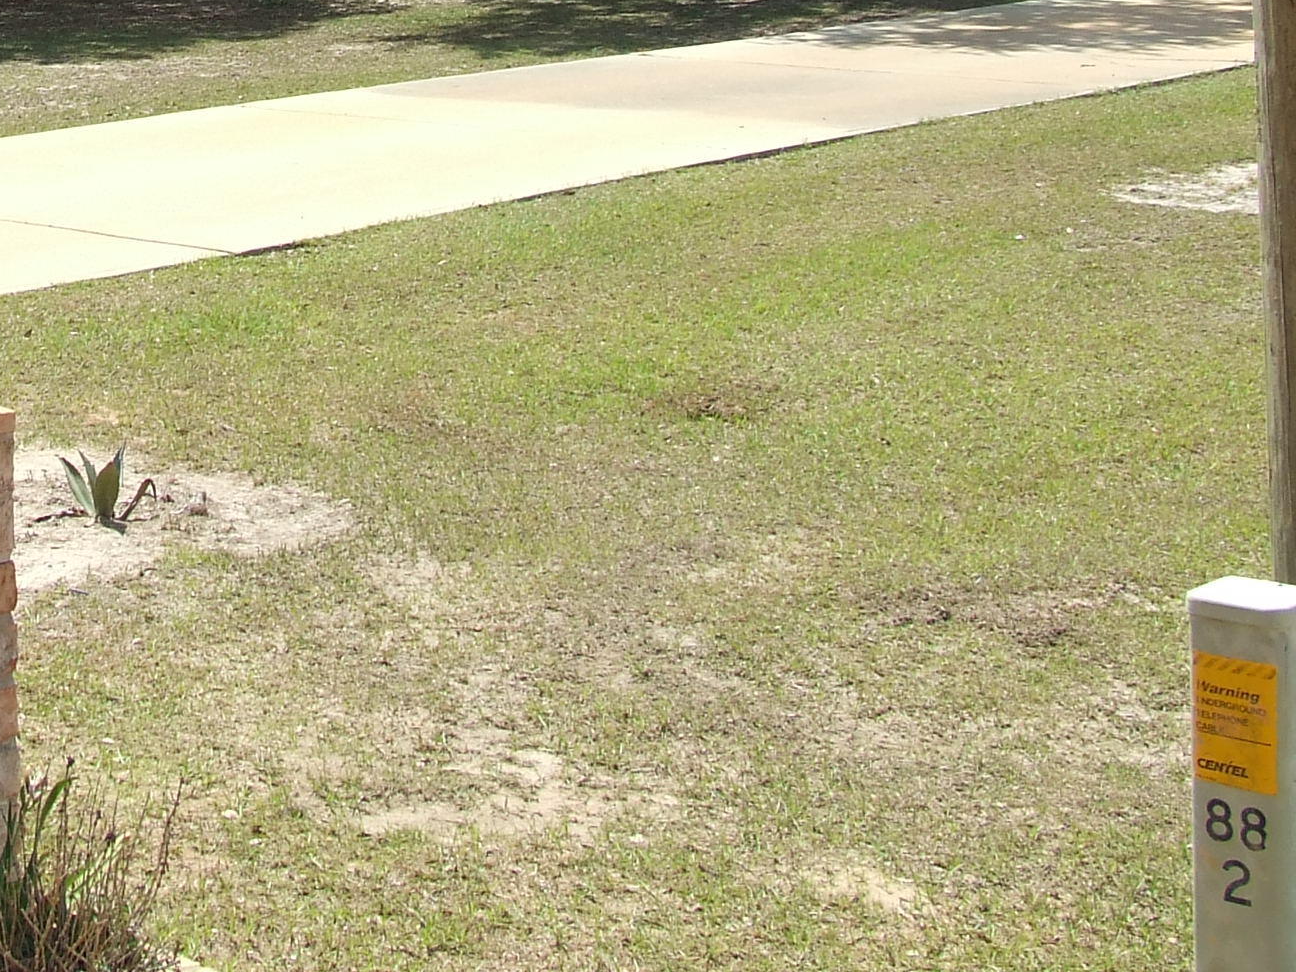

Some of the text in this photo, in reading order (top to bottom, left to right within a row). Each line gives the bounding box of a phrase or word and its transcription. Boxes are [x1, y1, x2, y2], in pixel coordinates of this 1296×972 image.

[1197, 757, 1249, 779] CENTEL
[1206, 797, 1266, 852] 88
[1222, 859, 1252, 908] 2
